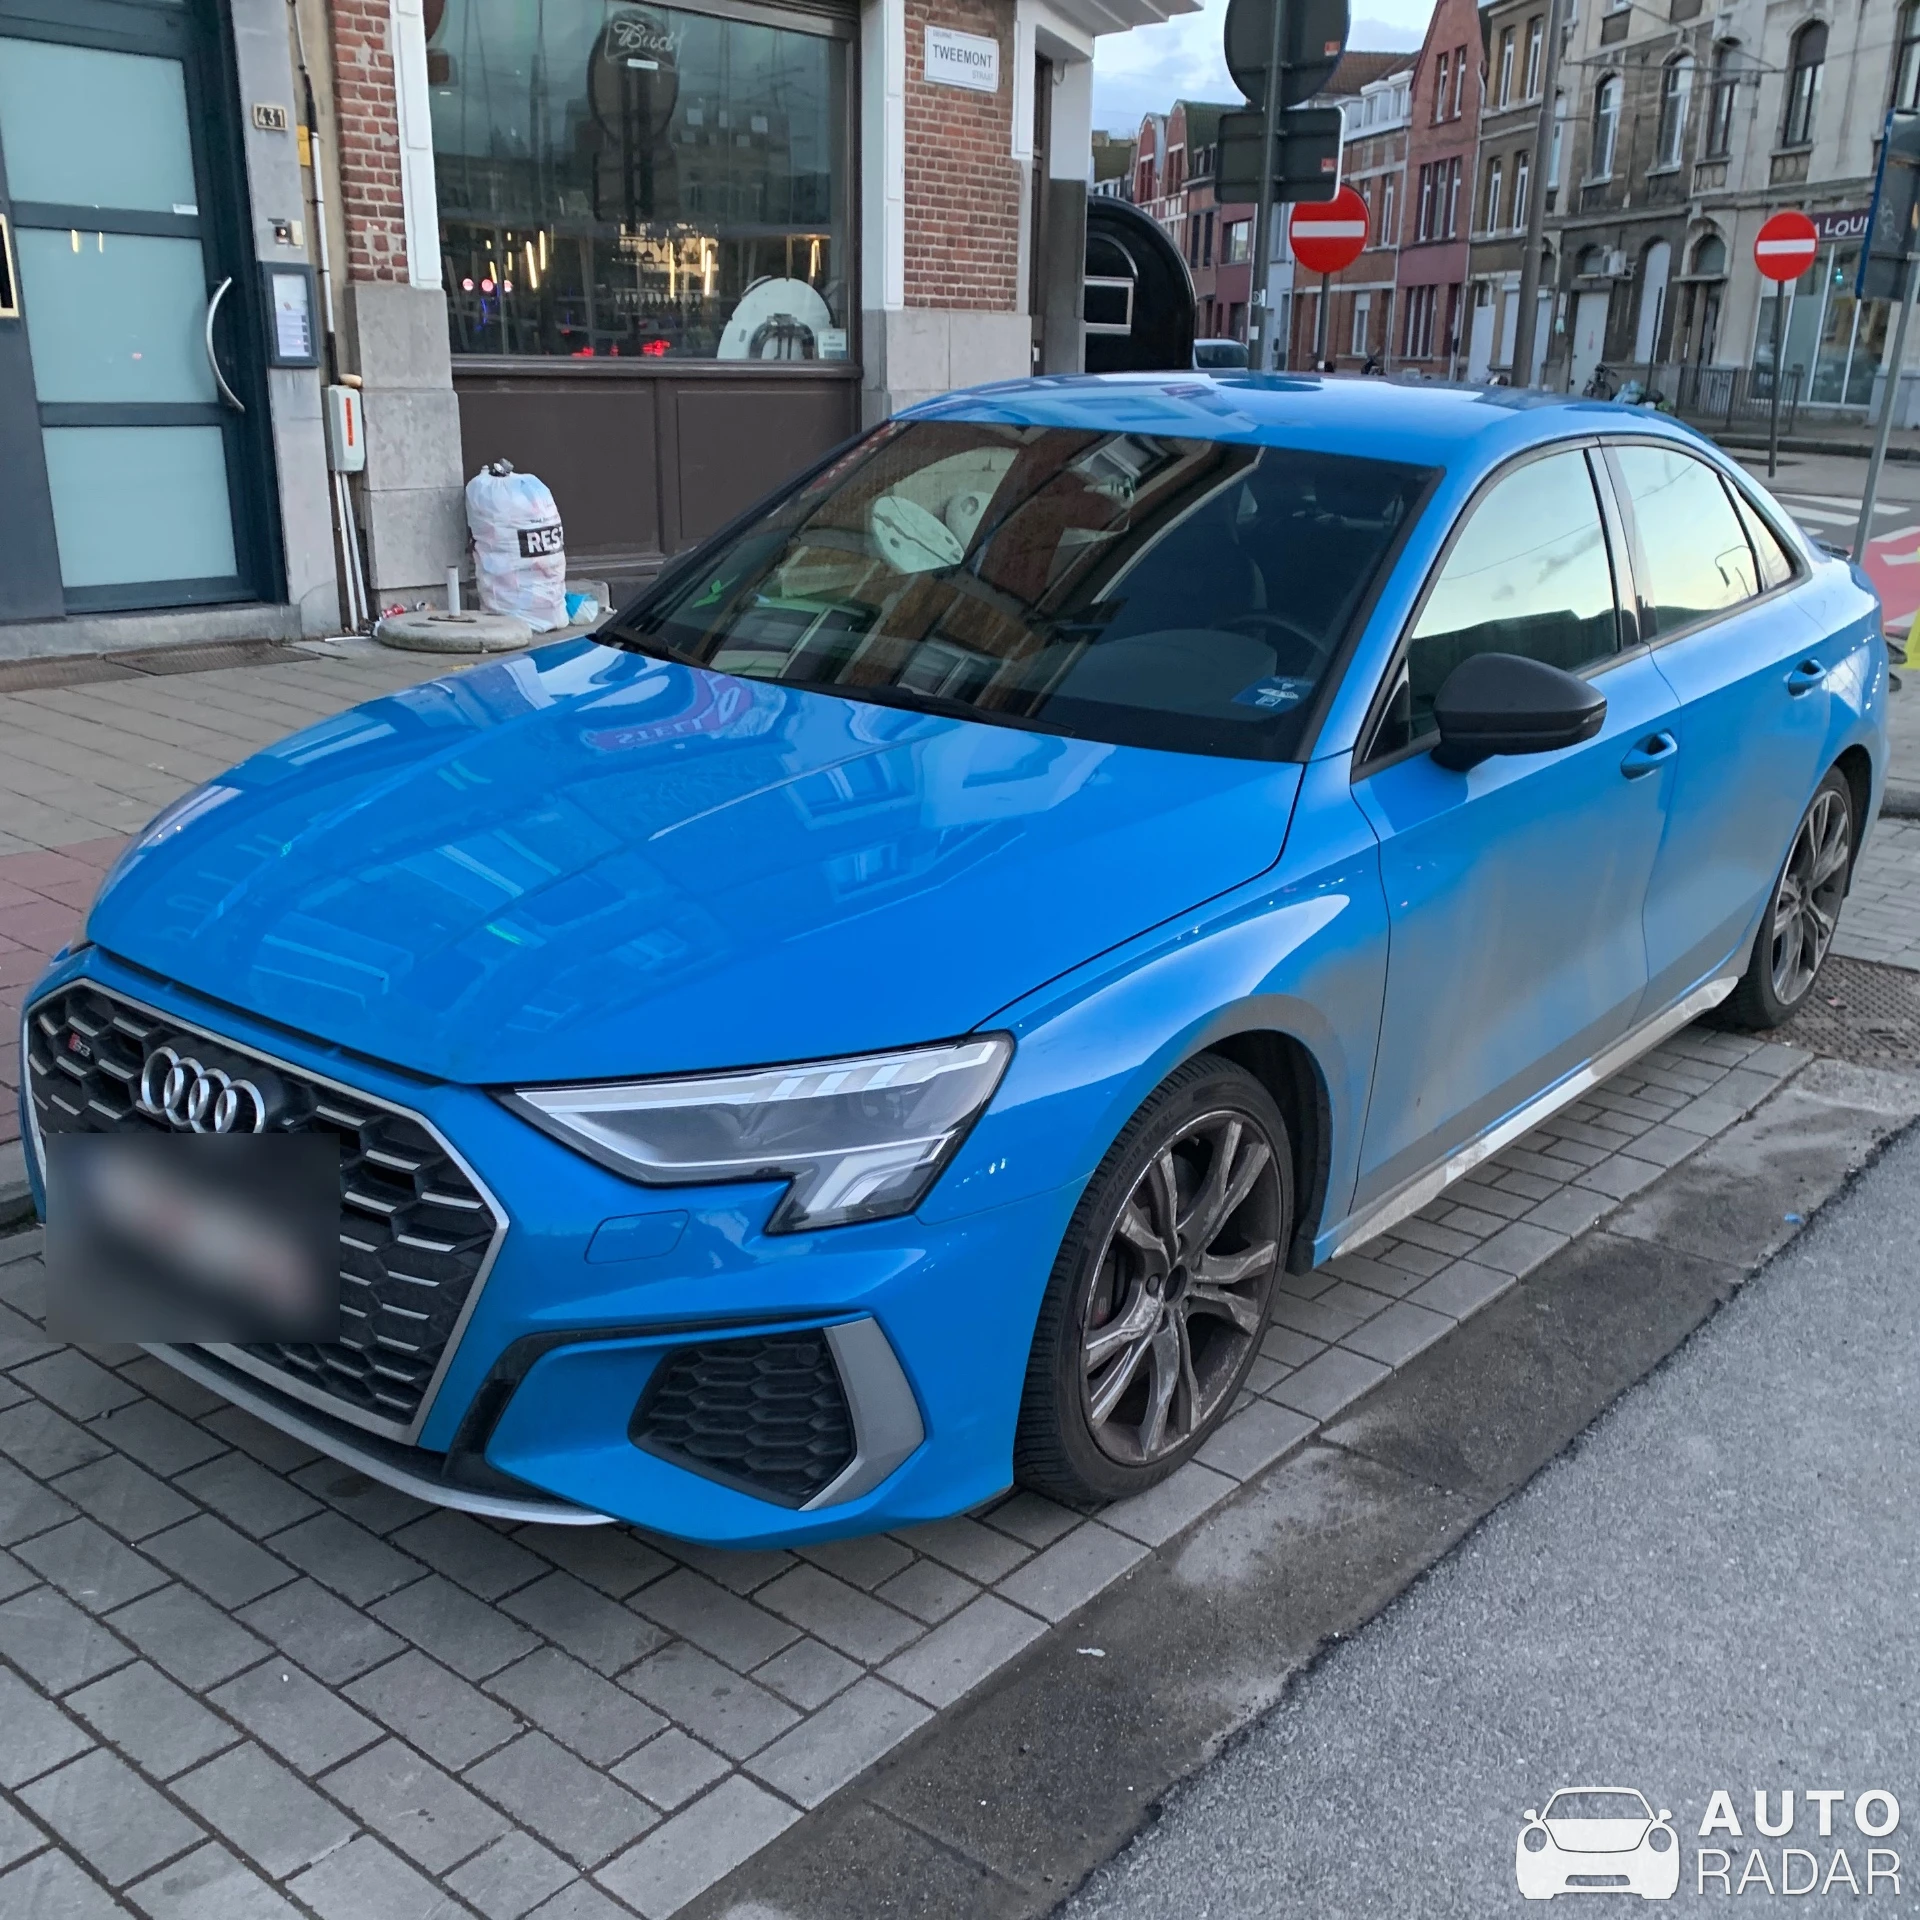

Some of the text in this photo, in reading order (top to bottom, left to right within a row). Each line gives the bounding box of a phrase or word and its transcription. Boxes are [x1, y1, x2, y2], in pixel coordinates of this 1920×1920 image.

[613, 21, 675, 51] Bud
[932, 44, 993, 68] TWEEMONT
[972, 69, 994, 80] STRAAT
[258, 107, 285, 128] 431
